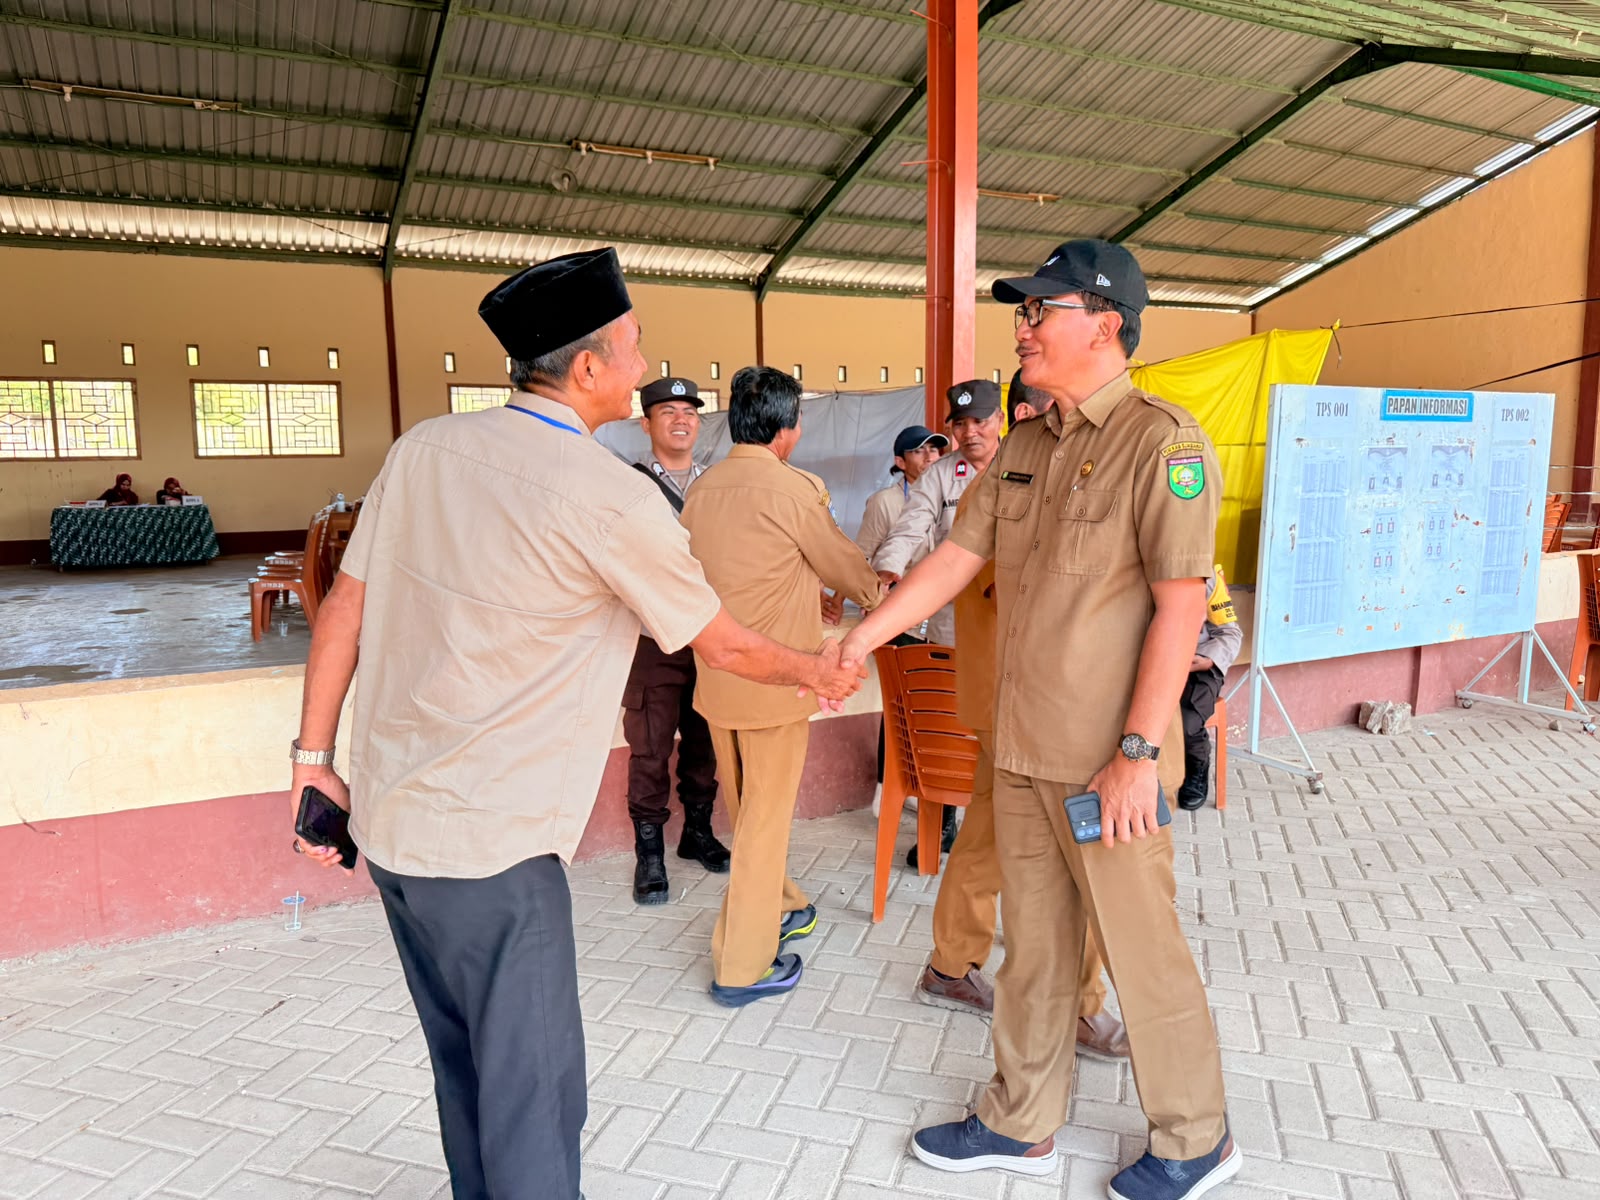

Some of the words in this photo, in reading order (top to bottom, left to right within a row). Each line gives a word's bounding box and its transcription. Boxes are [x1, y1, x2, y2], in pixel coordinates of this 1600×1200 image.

[1316, 402, 1331, 416] TPS
[1334, 402, 1348, 416] 001
[1388, 398, 1417, 413] PAPAN
[1420, 399, 1467, 415] INFORMASI
[1501, 408, 1514, 421] TPS
[1516, 408, 1529, 421] 002
